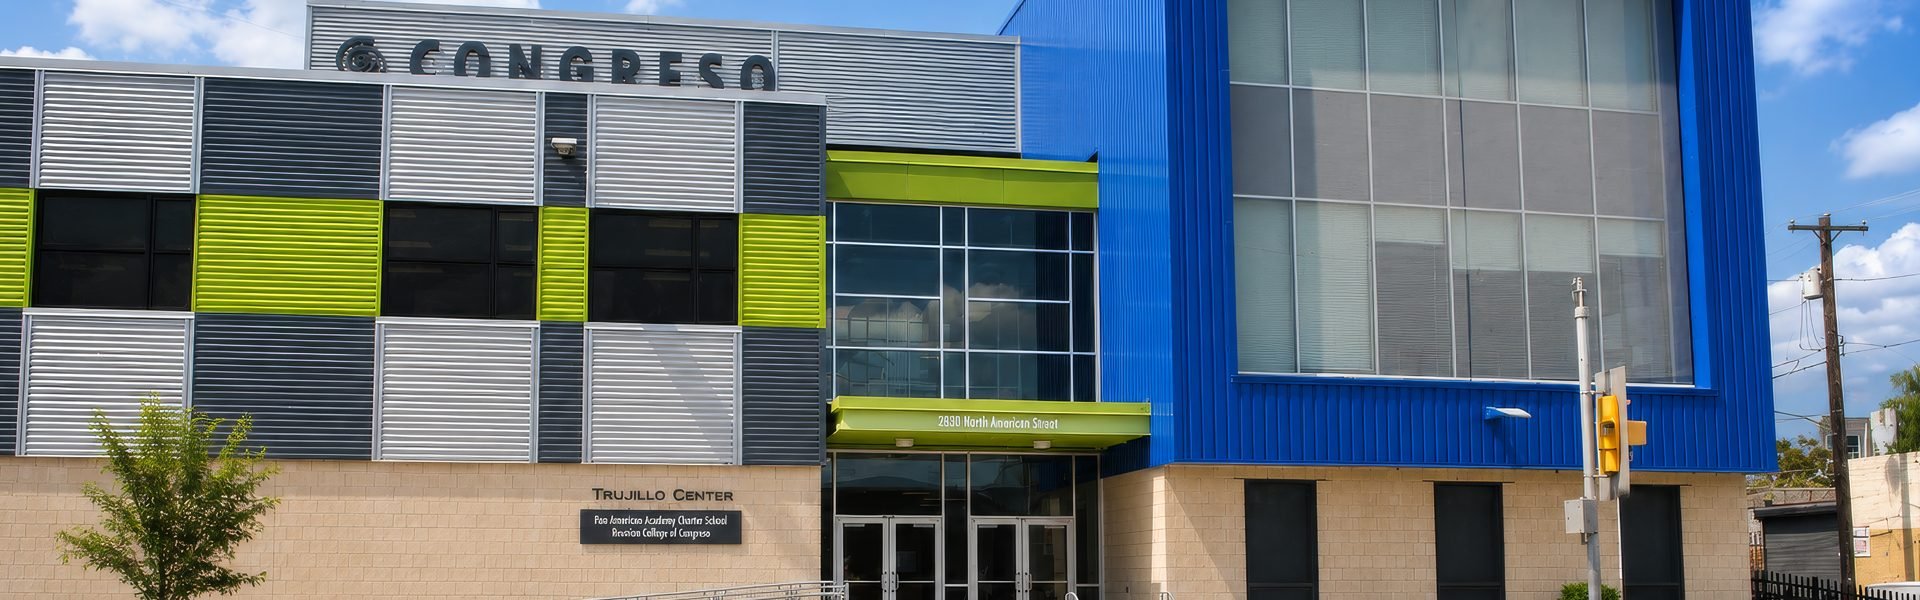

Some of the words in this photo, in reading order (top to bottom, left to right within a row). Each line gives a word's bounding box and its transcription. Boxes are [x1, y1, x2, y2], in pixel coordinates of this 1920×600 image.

[409, 39, 775, 91] CONGRESO
[964, 415, 988, 428] North
[990, 416, 1030, 429] American
[1032, 417, 1058, 429] Street
[609, 515, 643, 525] American
[644, 515, 676, 528] Academy
[678, 515, 703, 525] Charter
[705, 515, 728, 525] School
[642, 528, 668, 540] College
